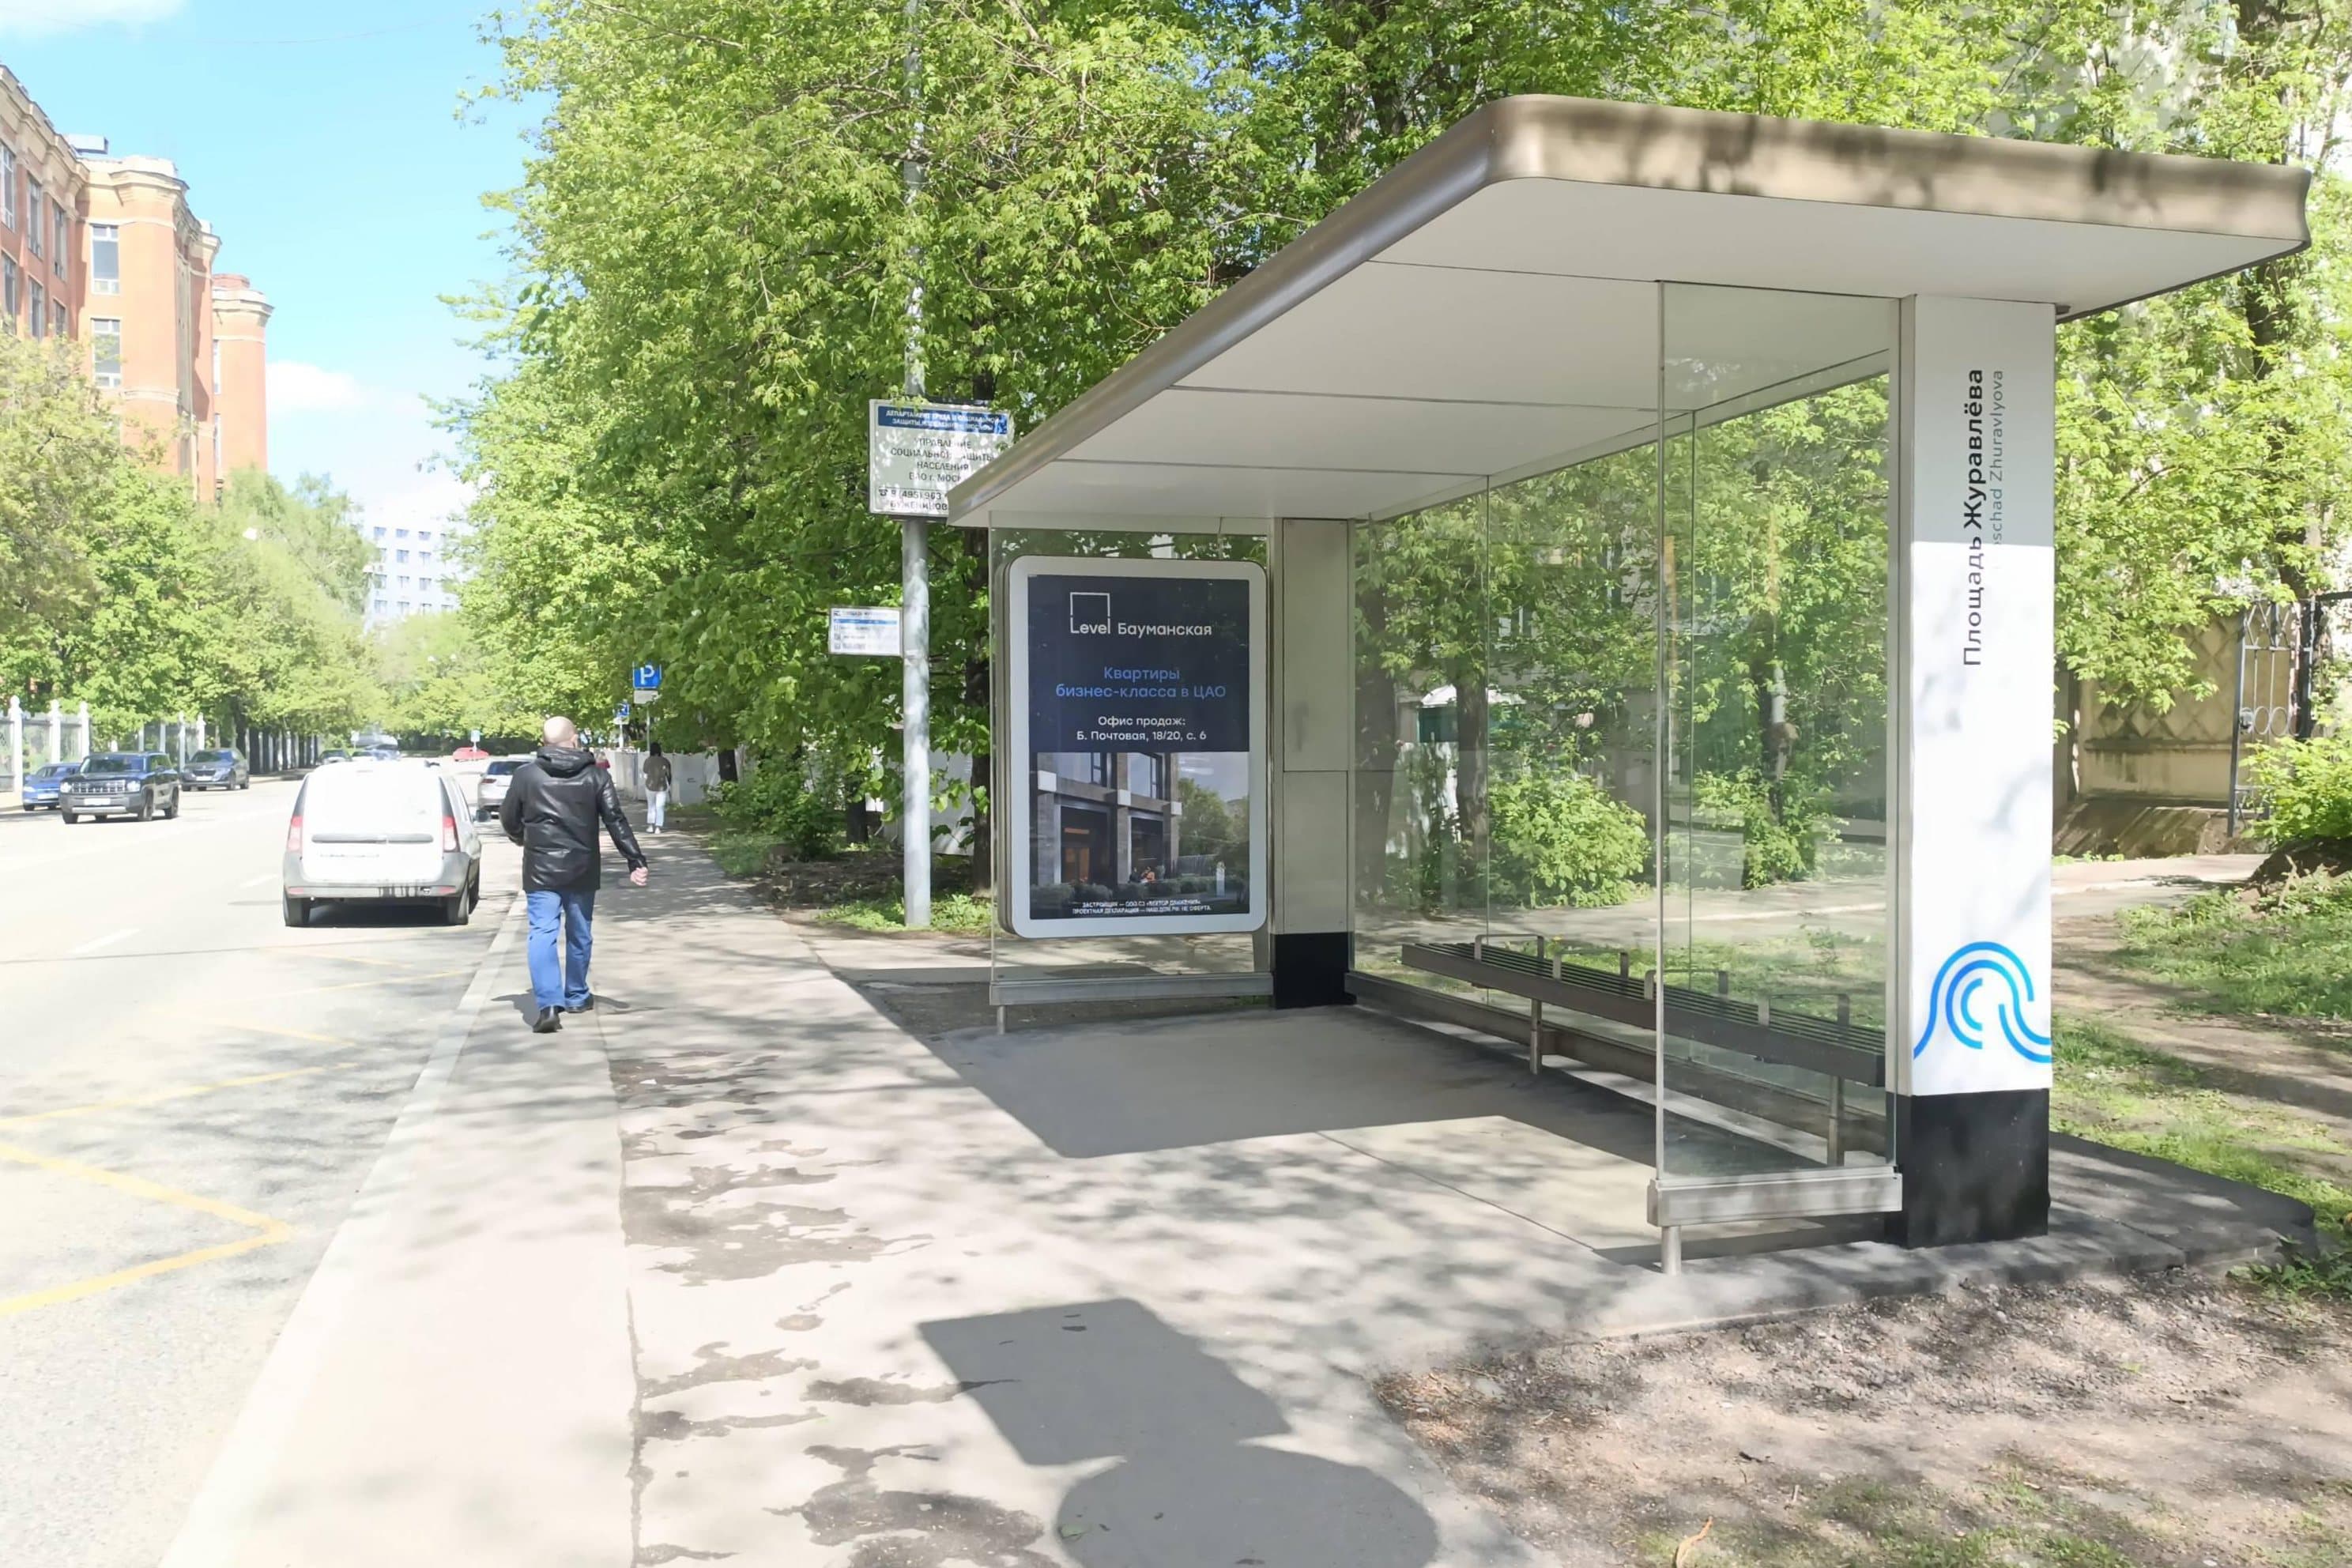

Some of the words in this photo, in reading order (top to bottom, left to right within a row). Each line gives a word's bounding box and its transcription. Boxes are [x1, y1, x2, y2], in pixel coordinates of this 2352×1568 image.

[1989, 370, 2006, 481] Zhuravlyova
[1964, 369, 1986, 530] Журавлёва
[917, 462, 969, 471] НАСЕЛЕНИЯ
[1989, 488, 2003, 545] schad
[1964, 536, 1984, 665] Площадь
[1070, 616, 1111, 634] Level
[1118, 623, 1212, 639] Бауманская
[1104, 666, 1180, 683] Квартиры
[1056, 684, 1176, 697] бизнес-класса
[1181, 688, 1189, 697] в
[1193, 685, 1226, 699] ЦАО
[1098, 716, 1133, 728] Офис
[1136, 717, 1186, 728] продаж:
[1076, 731, 1087, 741] Б.
[1091, 731, 1149, 741] Почтовая,
[1152, 731, 1183, 742] 18/20,
[1199, 731, 1207, 740] 6
